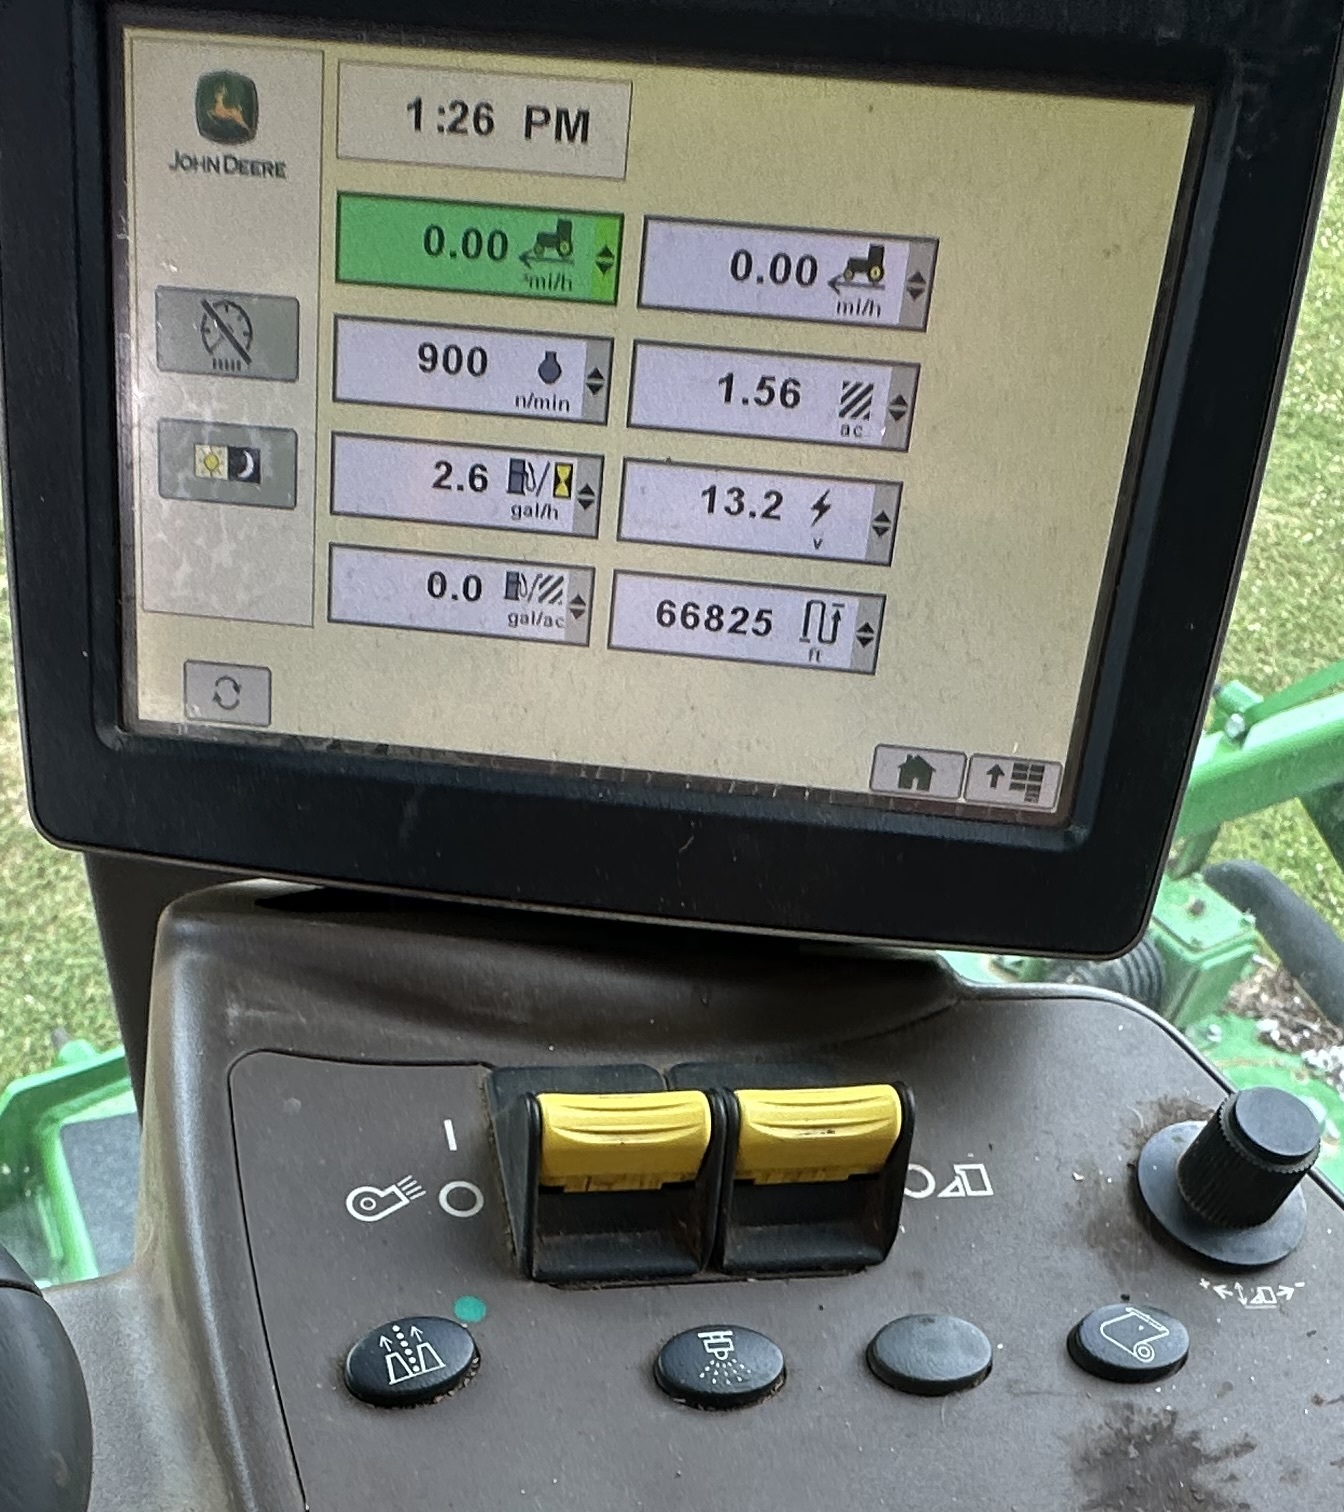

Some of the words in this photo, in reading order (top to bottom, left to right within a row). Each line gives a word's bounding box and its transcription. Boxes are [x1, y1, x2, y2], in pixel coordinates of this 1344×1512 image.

[406, 95, 496, 137] 1:26
[523, 104, 590, 144] PM
[167, 148, 220, 174] JOHN
[223, 154, 288, 180] DEERE
[422, 224, 510, 263] 0.00
[729, 248, 818, 287] 0.00
[835, 299, 882, 318] mi/h
[416, 341, 489, 378] 900
[514, 393, 571, 414] n/min
[717, 371, 802, 409] 1.56
[840, 422, 864, 439] ac
[430, 459, 490, 494] 2.6
[510, 500, 560, 522] gal/h
[701, 483, 785, 522] 13.2
[426, 570, 484, 604] 0.0
[506, 608, 565, 630] gal/ac
[655, 598, 774, 638] 66825
[807, 647, 822, 664] ft
